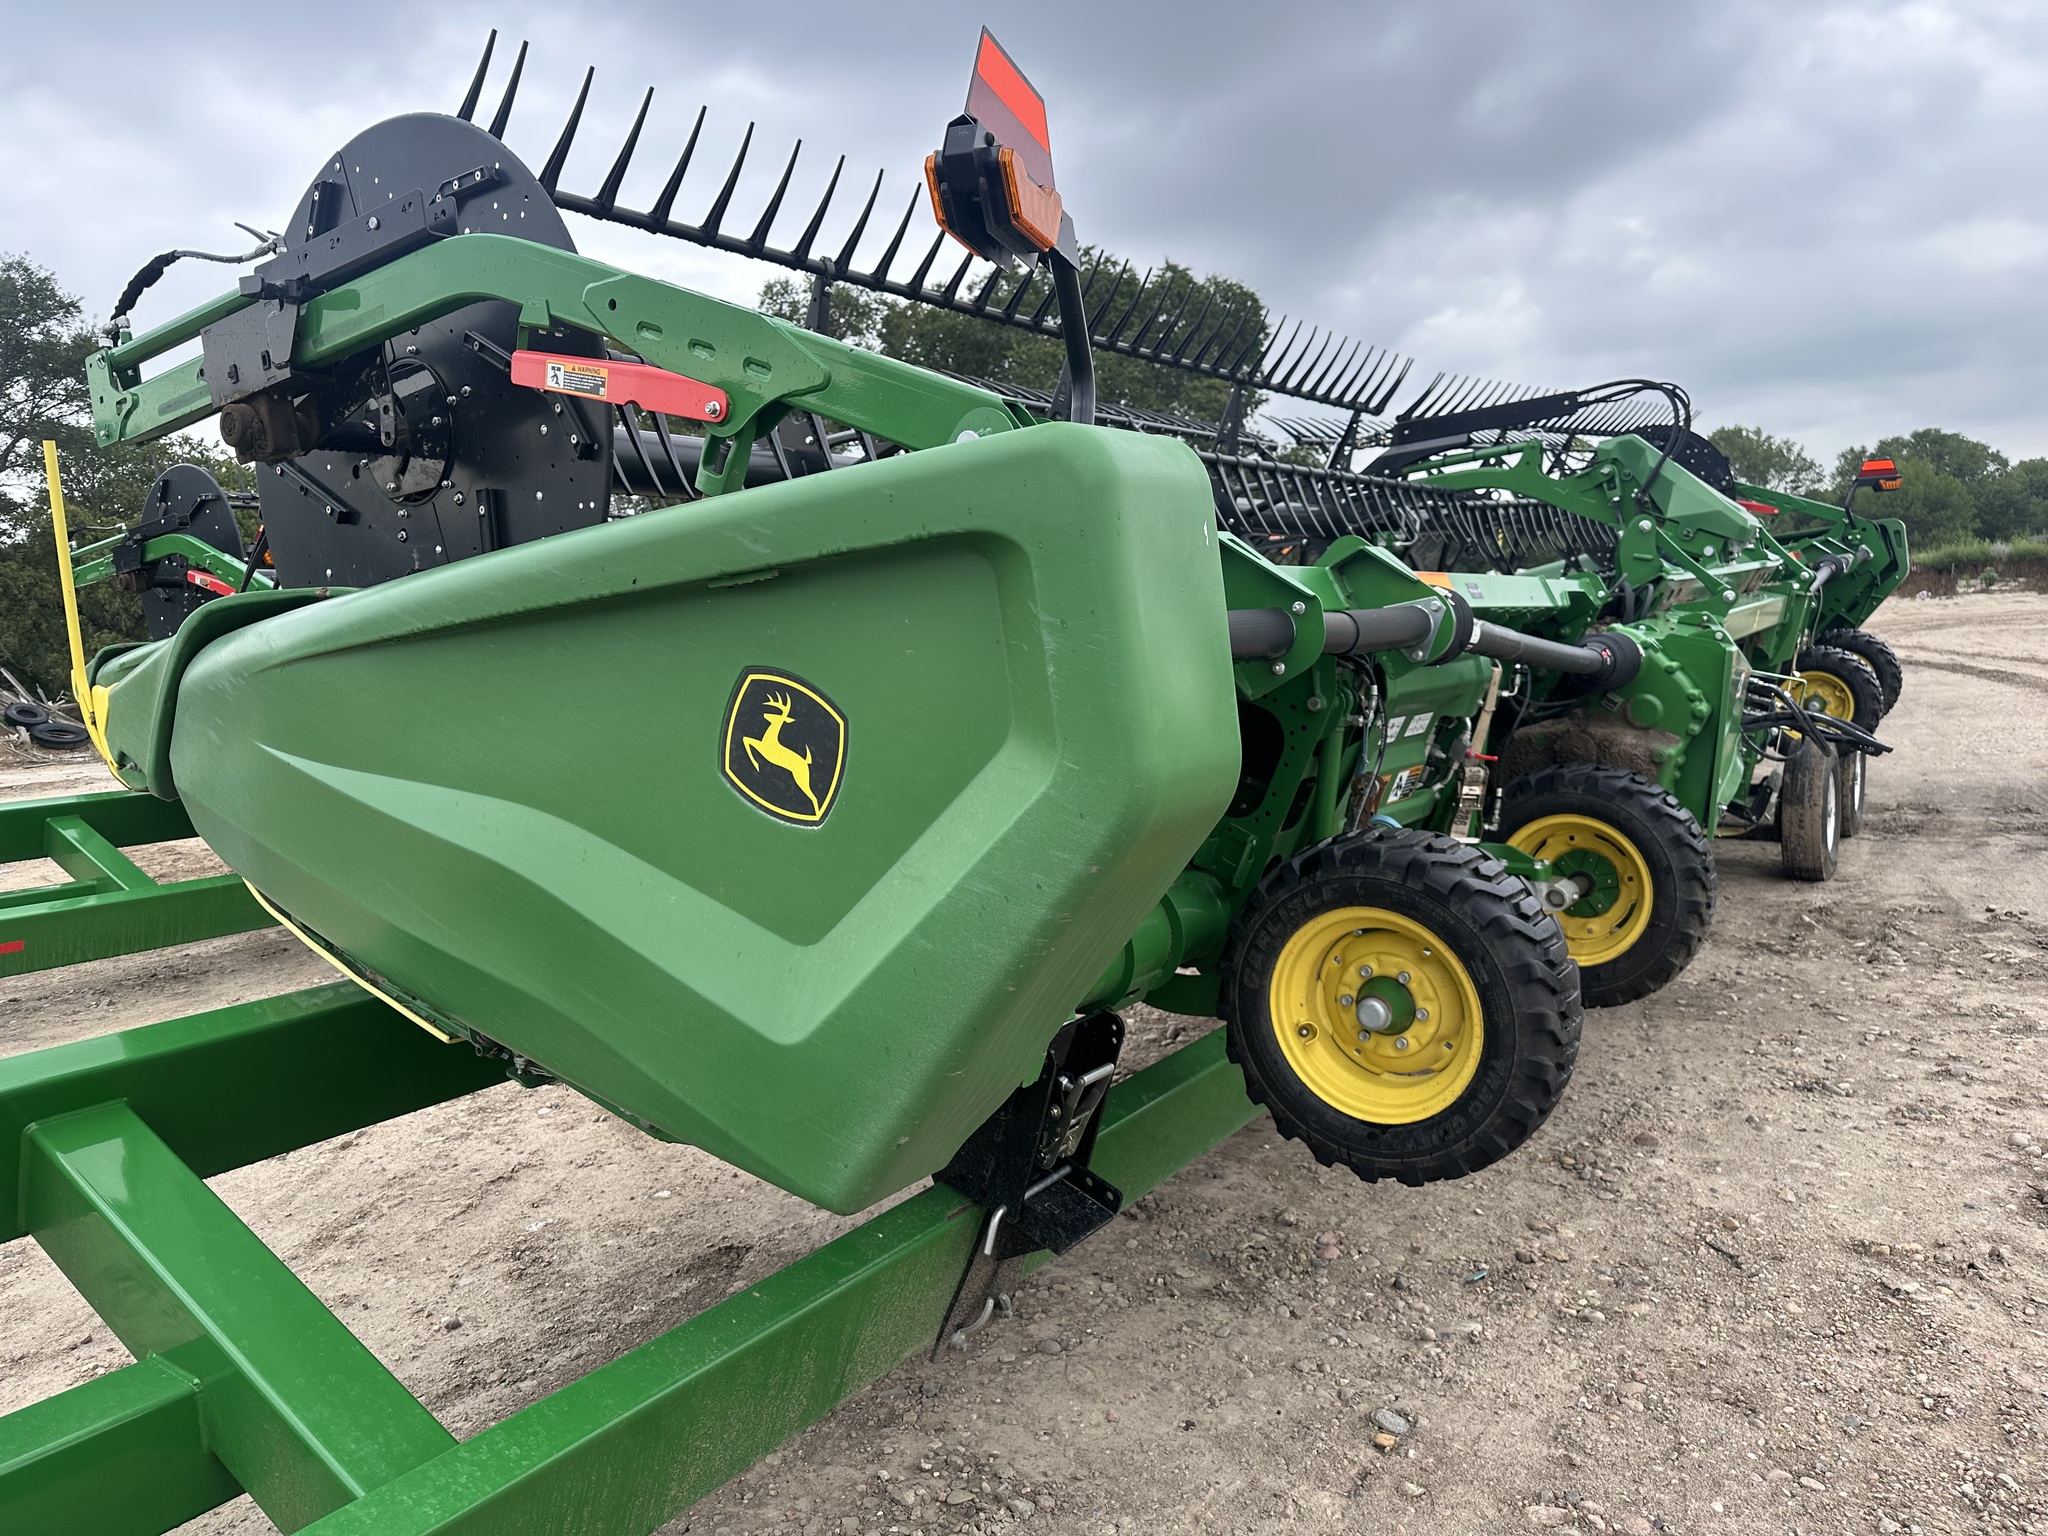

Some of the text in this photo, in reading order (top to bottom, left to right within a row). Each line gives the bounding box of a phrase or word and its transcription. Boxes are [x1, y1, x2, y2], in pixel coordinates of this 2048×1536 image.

[401, 203, 408, 215] 4
[329, 239, 336, 250] 2
[577, 366, 601, 376] WARNING
[1243, 881, 1341, 989] CARLISLE
